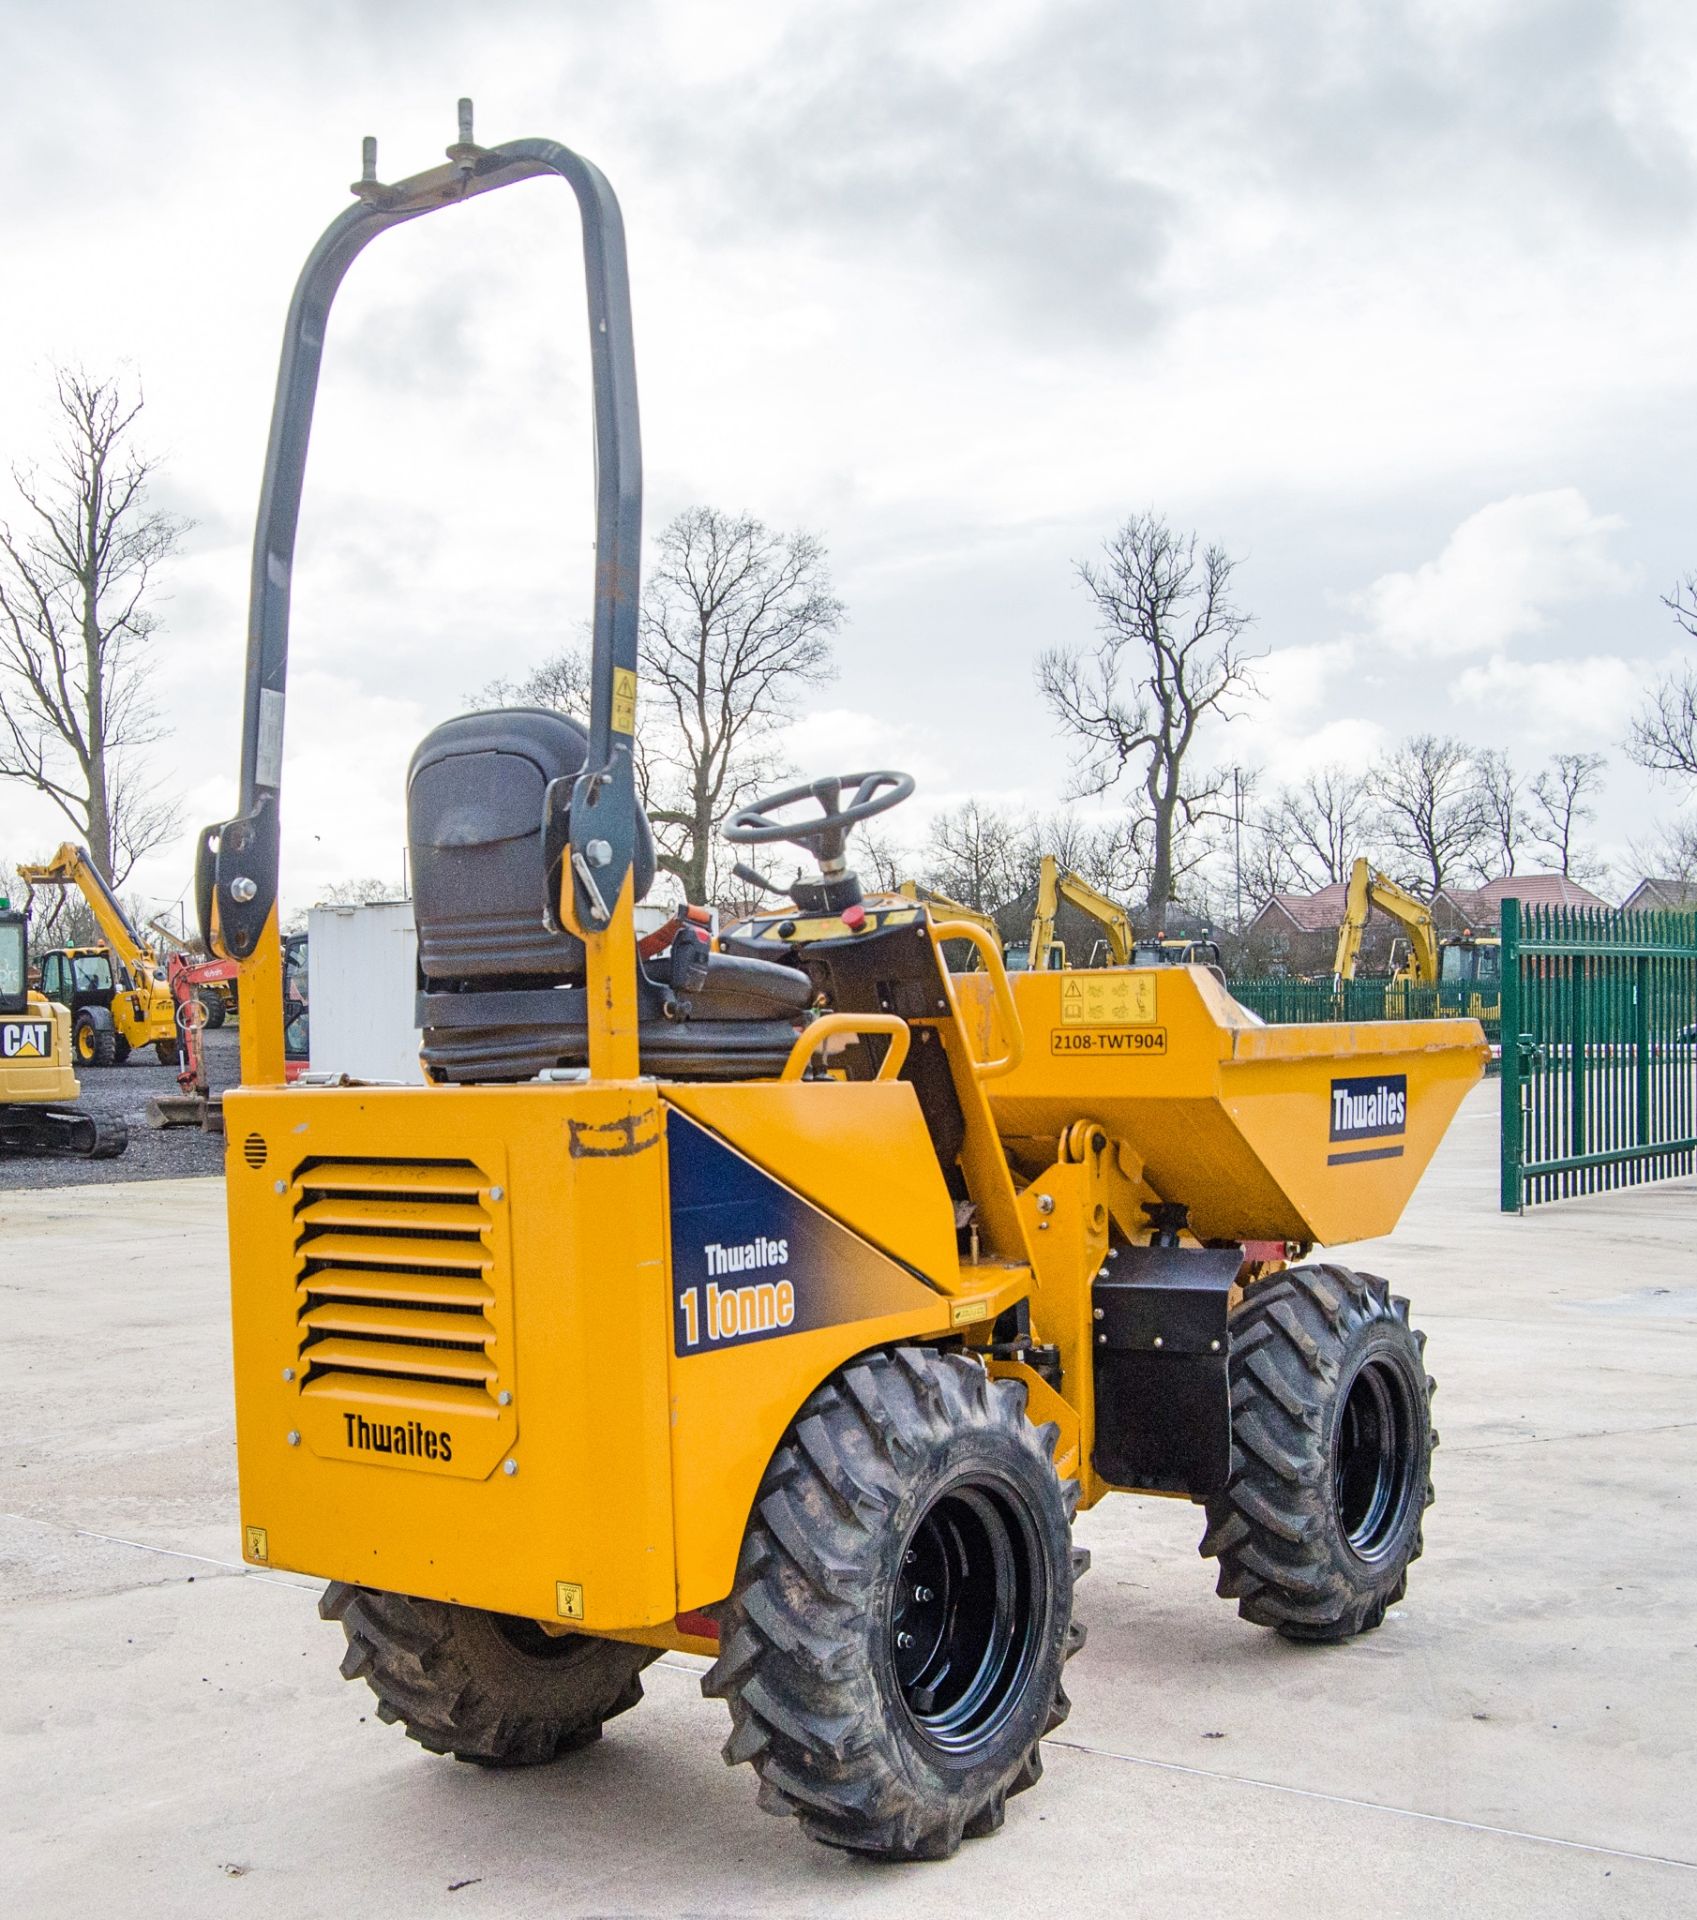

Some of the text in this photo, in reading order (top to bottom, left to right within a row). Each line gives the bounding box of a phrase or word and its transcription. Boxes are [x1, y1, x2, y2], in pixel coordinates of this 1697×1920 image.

[3, 1024, 48, 1057] CAT
[1054, 1034, 1164, 1049] 2108-TWT904
[1333, 1086, 1405, 1131] Thwaites
[704, 1236, 789, 1276] Thwaites
[680, 1279, 796, 1346] 1 tonne
[343, 1412, 452, 1462] Thwaites
